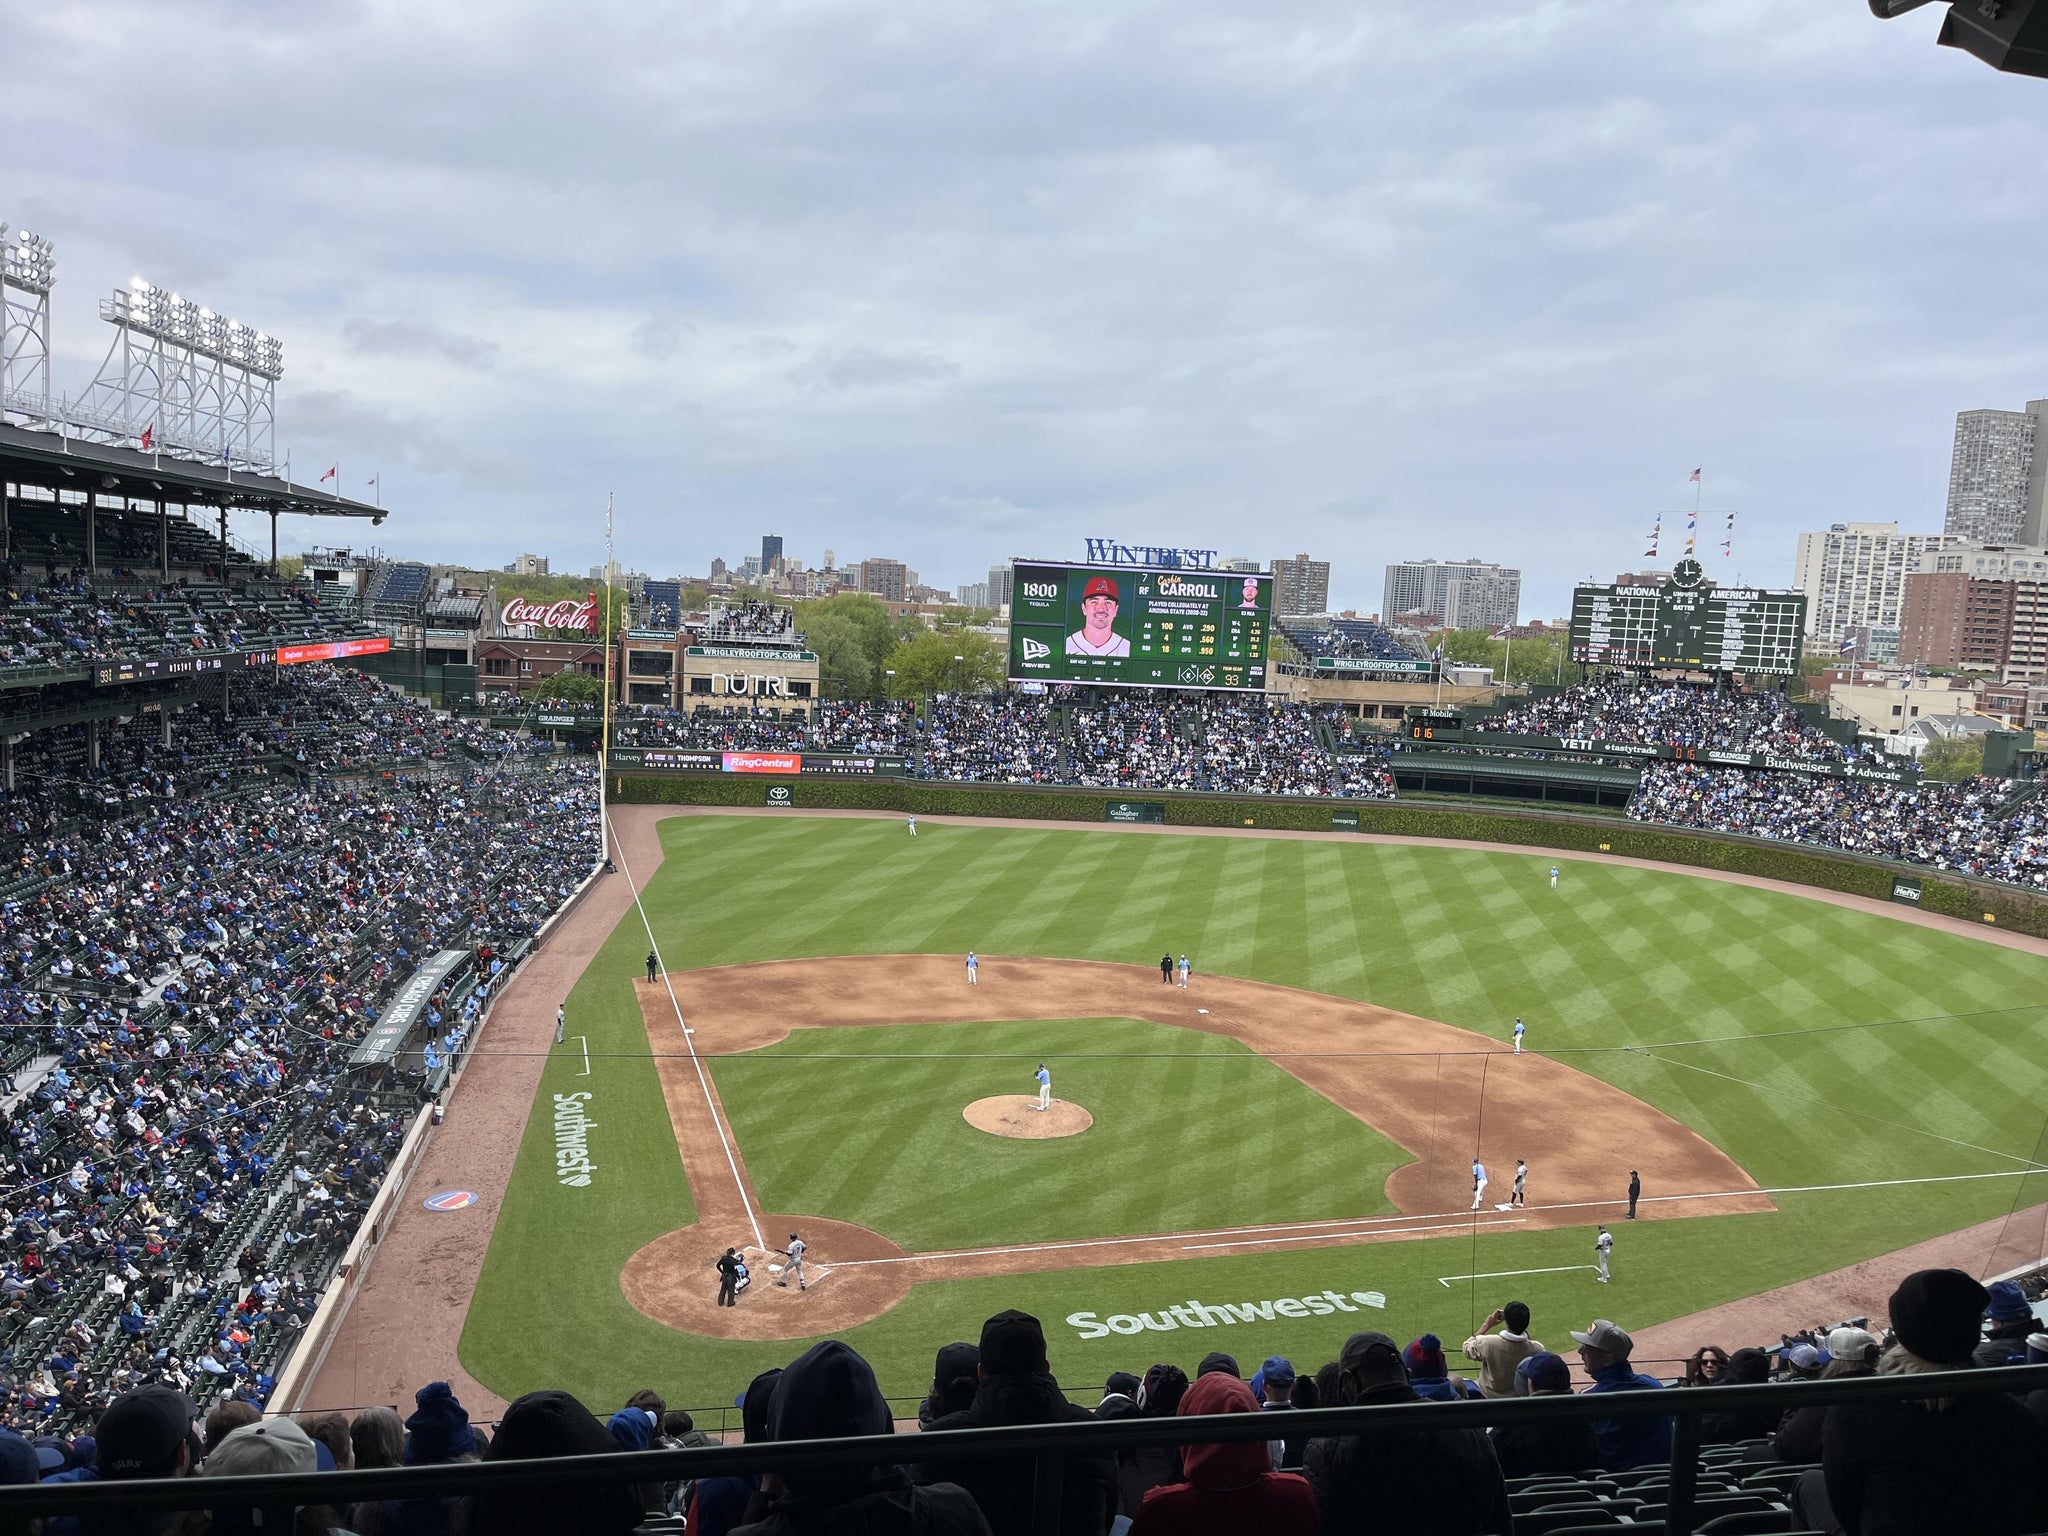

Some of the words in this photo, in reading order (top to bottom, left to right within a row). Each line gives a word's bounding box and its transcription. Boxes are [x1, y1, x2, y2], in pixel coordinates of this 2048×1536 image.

[1084, 538, 1217, 568] WINTRUST
[1142, 574, 1148, 582] 7
[1023, 583, 1057, 598] 1800
[1139, 587, 1149, 595] RF
[1160, 583, 1218, 598] CARROLL
[1616, 587, 1661, 597] NATIONAL
[1709, 590, 1759, 600] AMERICAN
[501, 598, 594, 630] Coca-Cola
[703, 648, 800, 659] WRIGLEYROOFTOPS.COM
[1333, 659, 1416, 670] WRIGLEYROOFTOPS.COM
[1430, 710, 1453, 718] Mobile
[1560, 738, 1593, 750] YETI
[1611, 744, 1657, 754] tastytrade
[615, 753, 641, 762] Harvey
[1709, 751, 1751, 761] GRAINGER
[731, 757, 793, 769] RingCentral
[1765, 757, 1829, 773] Budweiser
[1857, 768, 1901, 780] Advocate
[1110, 809, 1139, 818] Gallagher
[1332, 818, 1358, 826] Invenergy
[1896, 886, 1919, 899] Hefty
[400, 976, 434, 1003] CHICAGO
[387, 1004, 415, 1024] CUBS
[554, 1092, 598, 1175] Southwest
[1066, 1291, 1358, 1339] Southwest
